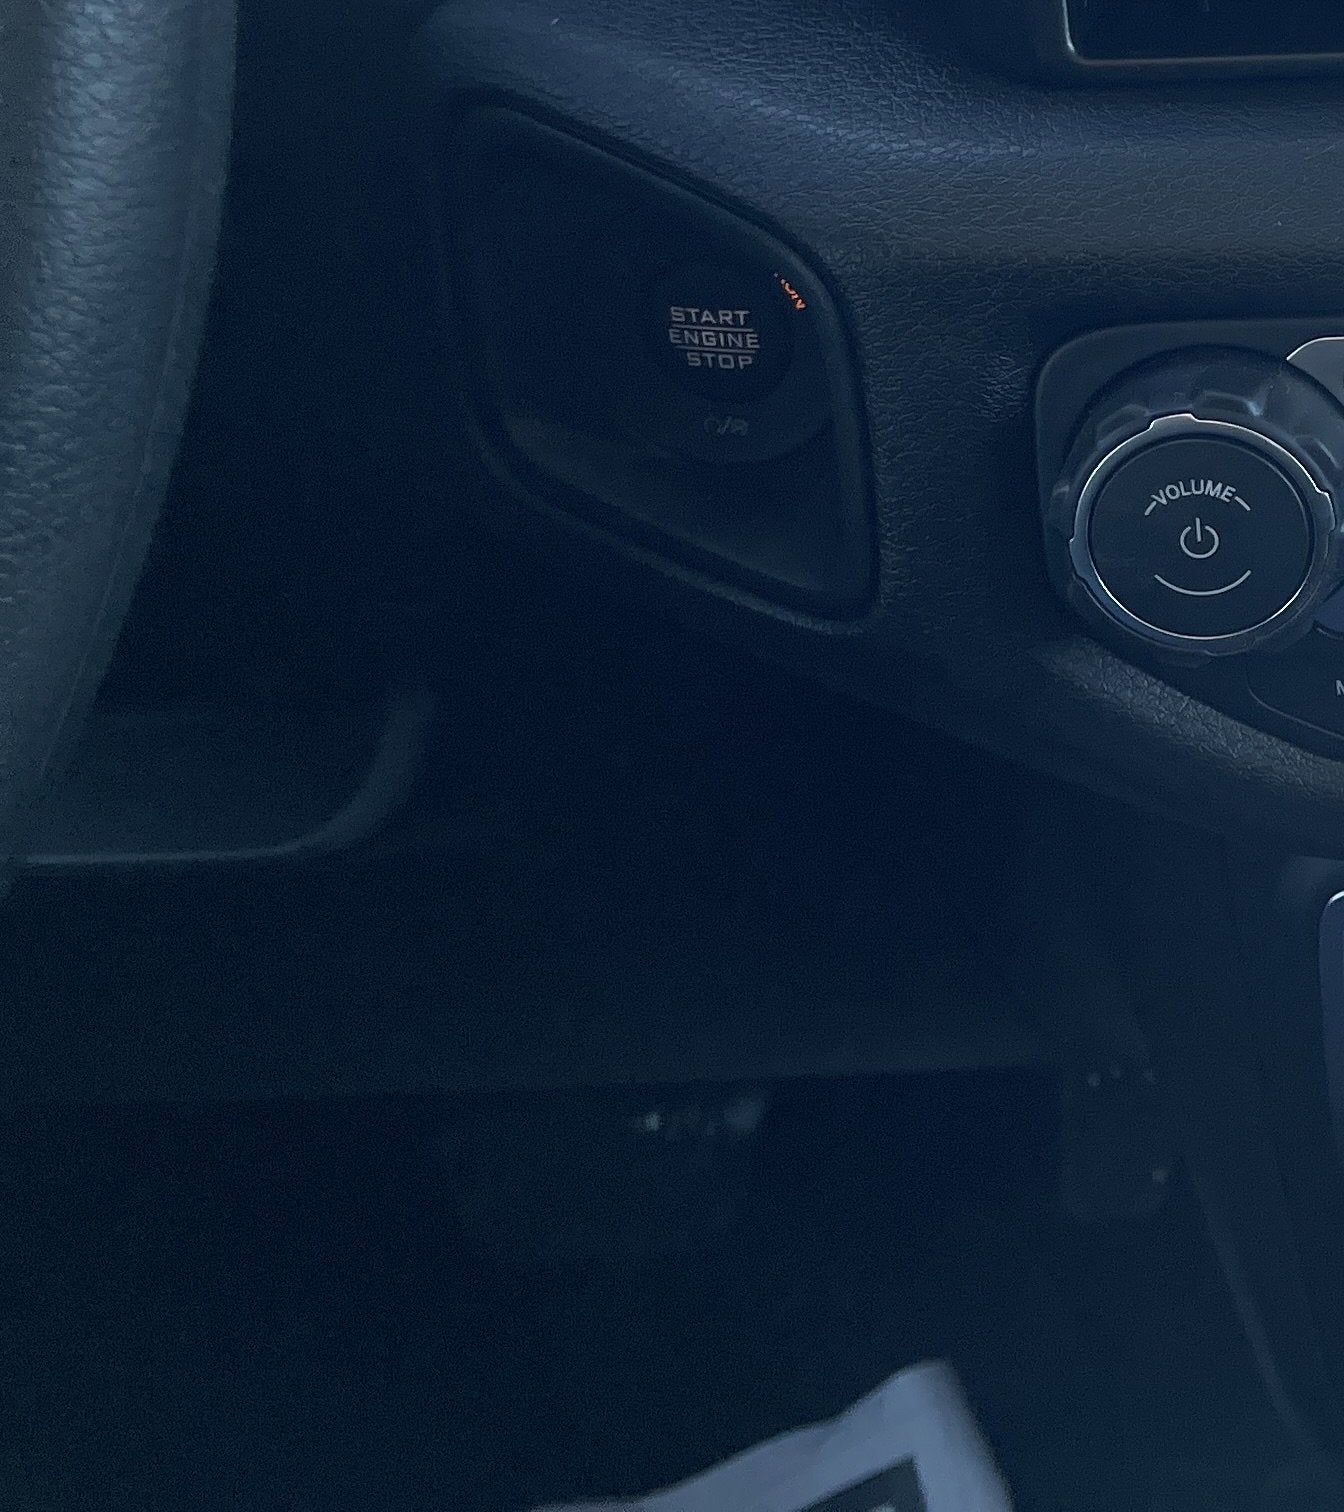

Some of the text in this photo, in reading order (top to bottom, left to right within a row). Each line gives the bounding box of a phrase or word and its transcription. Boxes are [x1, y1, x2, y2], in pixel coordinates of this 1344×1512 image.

[670, 306, 751, 327] START
[668, 328, 760, 350] ENGINE
[686, 351, 753, 370] STOP
[1151, 479, 1237, 508] VOLUME
